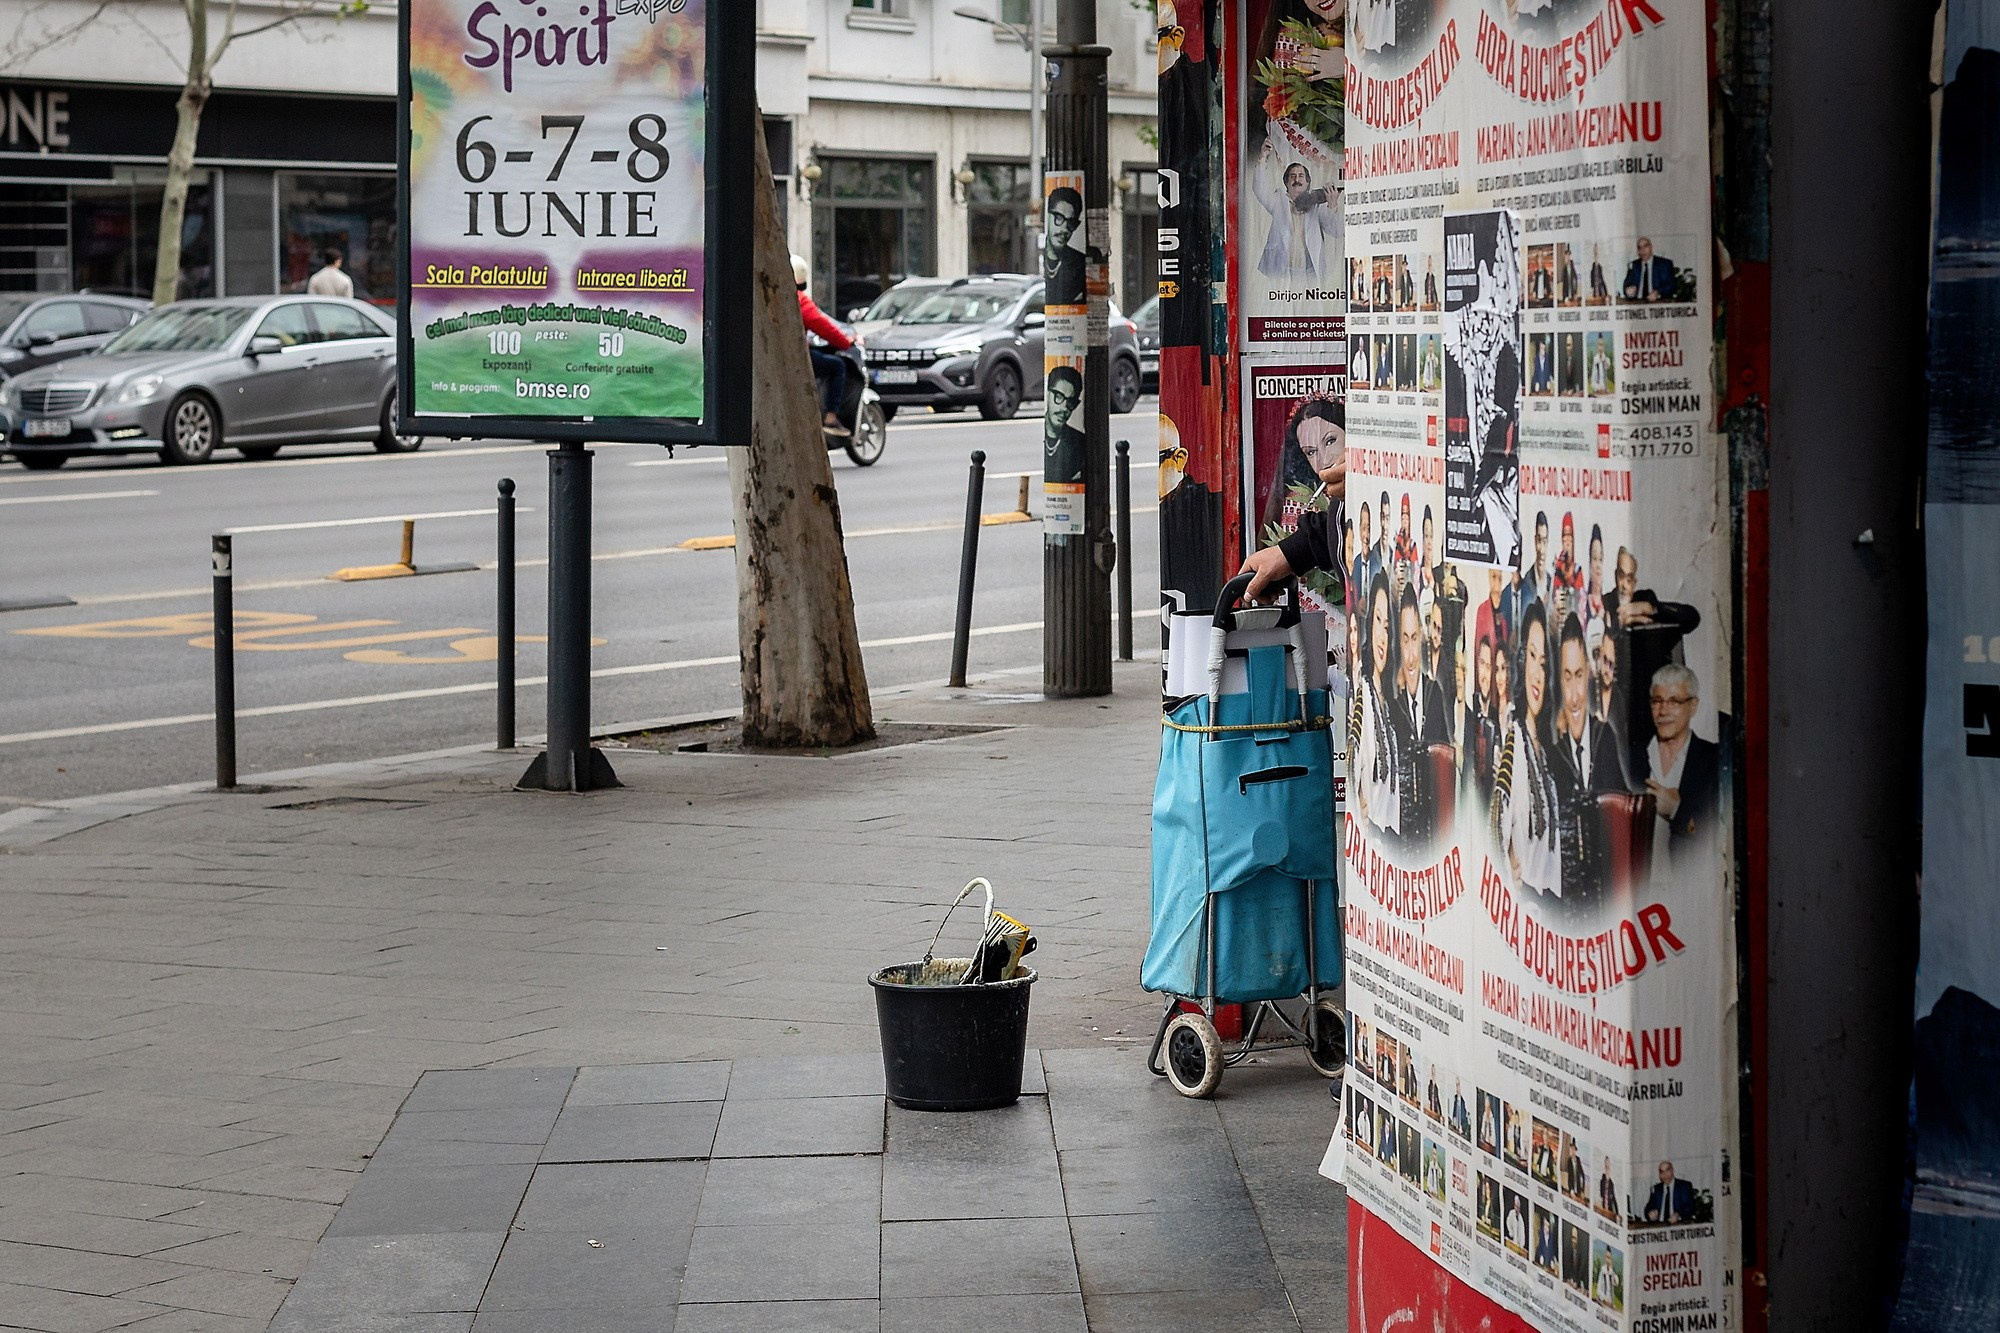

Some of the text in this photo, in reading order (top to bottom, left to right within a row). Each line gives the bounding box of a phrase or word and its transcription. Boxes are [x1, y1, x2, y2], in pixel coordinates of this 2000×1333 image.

[464, 0, 616, 92] Spirit
[1475, 9, 1515, 93] HORA
[1477, 122, 1515, 165] MARIAN
[1526, 114, 1547, 158] ANA
[1371, 142, 1388, 178] ANA
[463, 191, 658, 237] IUNIE
[426, 265, 548, 286] Sala Palatului
[577, 268, 687, 288] Intrarea liberă!
[1269, 290, 1302, 303] Dirijor
[426, 318, 446, 339] cel
[444, 312, 469, 334] mai
[469, 310, 501, 328] mare
[527, 302, 574, 322] dedicat
[574, 305, 602, 324] unei
[1264, 321, 1296, 329] Biletele
[1310, 321, 1325, 331] pot
[487, 329, 624, 357] 100 peste: 50
[1272, 330, 1298, 338] online
[482, 359, 532, 373] Expozanți
[566, 362, 655, 376] Conferințe gratuite
[1622, 350, 1683, 369] SPECIALI
[431, 381, 500, 394] Info & program:
[515, 378, 591, 399] bmse.ro
[1258, 378, 1322, 396] CONCERT
[1480, 854, 1519, 957] HORA
[1523, 903, 1686, 1010] BUCUREȘTILOR
[1375, 917, 1392, 958] ANA
[1392, 926, 1420, 970] MARIA
[1420, 940, 1465, 995] MEXICANU
[1482, 970, 1519, 1020] MARIAN
[1531, 992, 1552, 1037] ANA
[1554, 1001, 1588, 1053] MARIA
[1591, 1016, 1682, 1071] MEXICANU
[1643, 1269, 1702, 1291] SPECIALI
[1641, 1302, 1667, 1317] Regia
[1687, 1313, 1717, 1333] MAN
